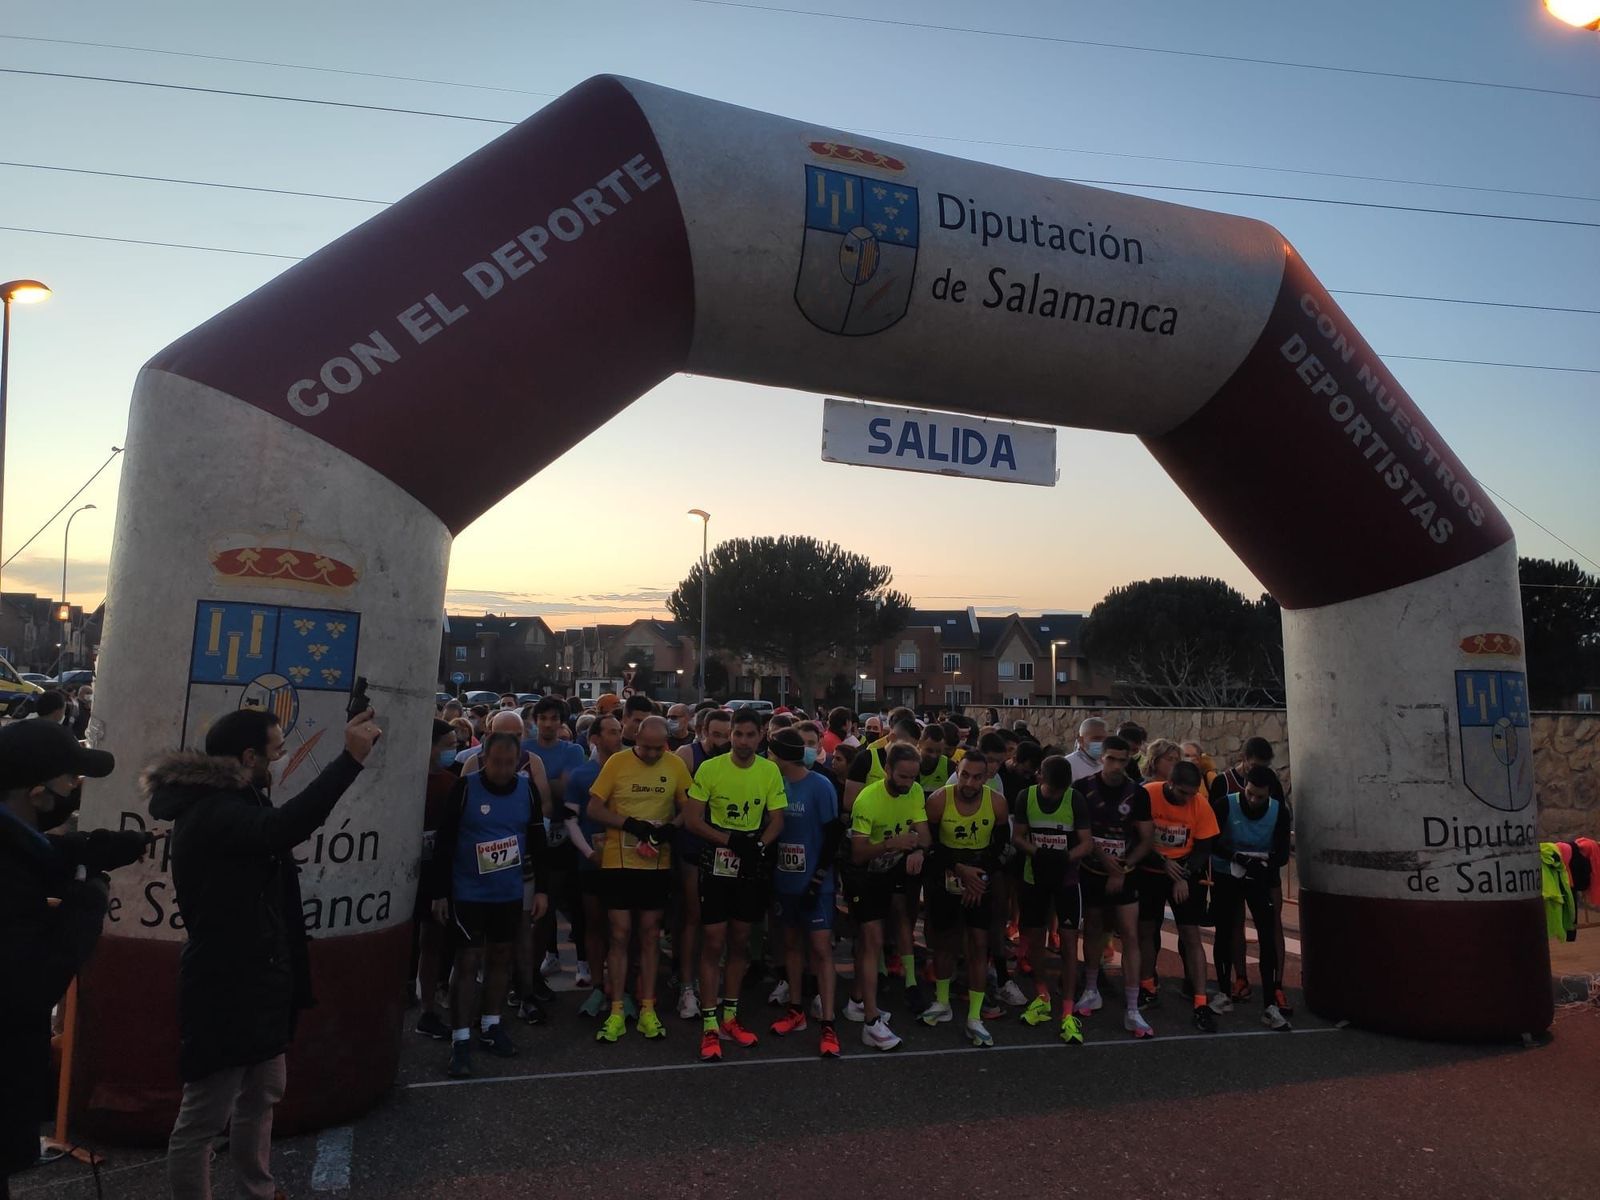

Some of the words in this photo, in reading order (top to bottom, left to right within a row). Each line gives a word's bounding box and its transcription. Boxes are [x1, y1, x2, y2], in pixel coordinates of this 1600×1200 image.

[937, 192, 1144, 265] Diputación
[286, 330, 401, 417] CON
[396, 292, 470, 345] EL
[462, 153, 662, 300] DEPORTE
[931, 268, 967, 303] de
[982, 267, 1178, 336] Salamanca
[868, 417, 1017, 471] SALIDA
[1279, 333, 1454, 544] DEPORTISTAS
[1300, 292, 1356, 364] CON
[1356, 363, 1486, 528] NUESTROS
[491, 849, 508, 864] 97
[1407, 867, 1440, 893] de
